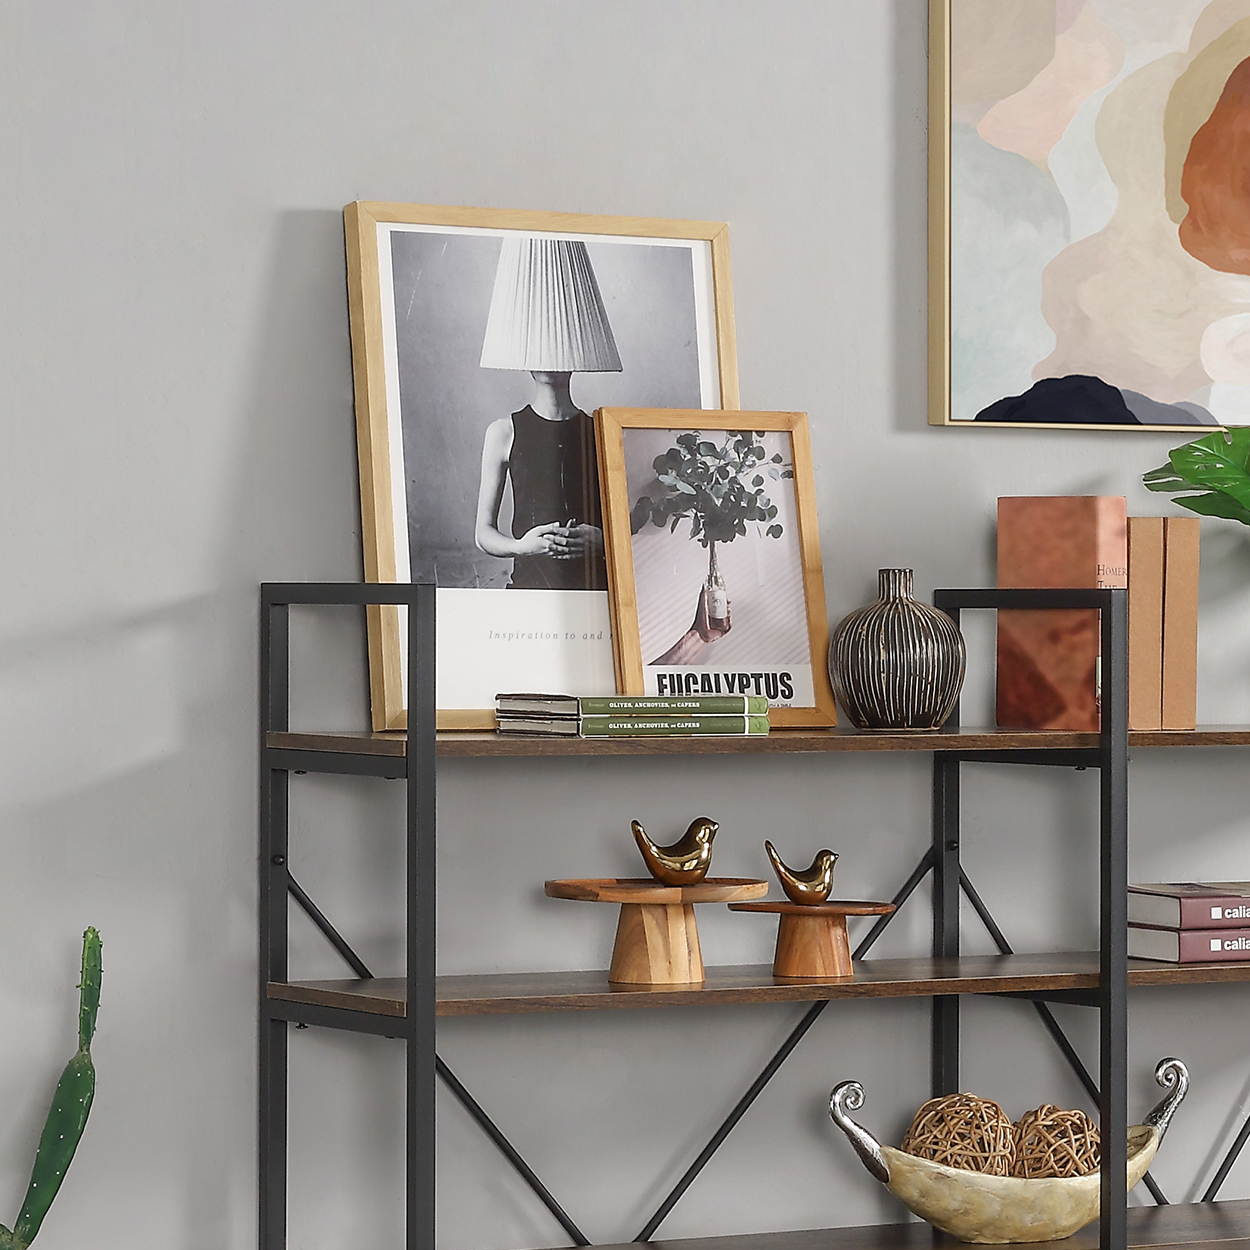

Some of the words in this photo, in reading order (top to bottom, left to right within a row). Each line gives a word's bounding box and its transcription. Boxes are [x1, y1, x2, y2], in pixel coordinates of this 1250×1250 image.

[489, 630, 558, 642] Inspiration
[565, 632, 576, 640] to
[582, 631, 602, 640] and
